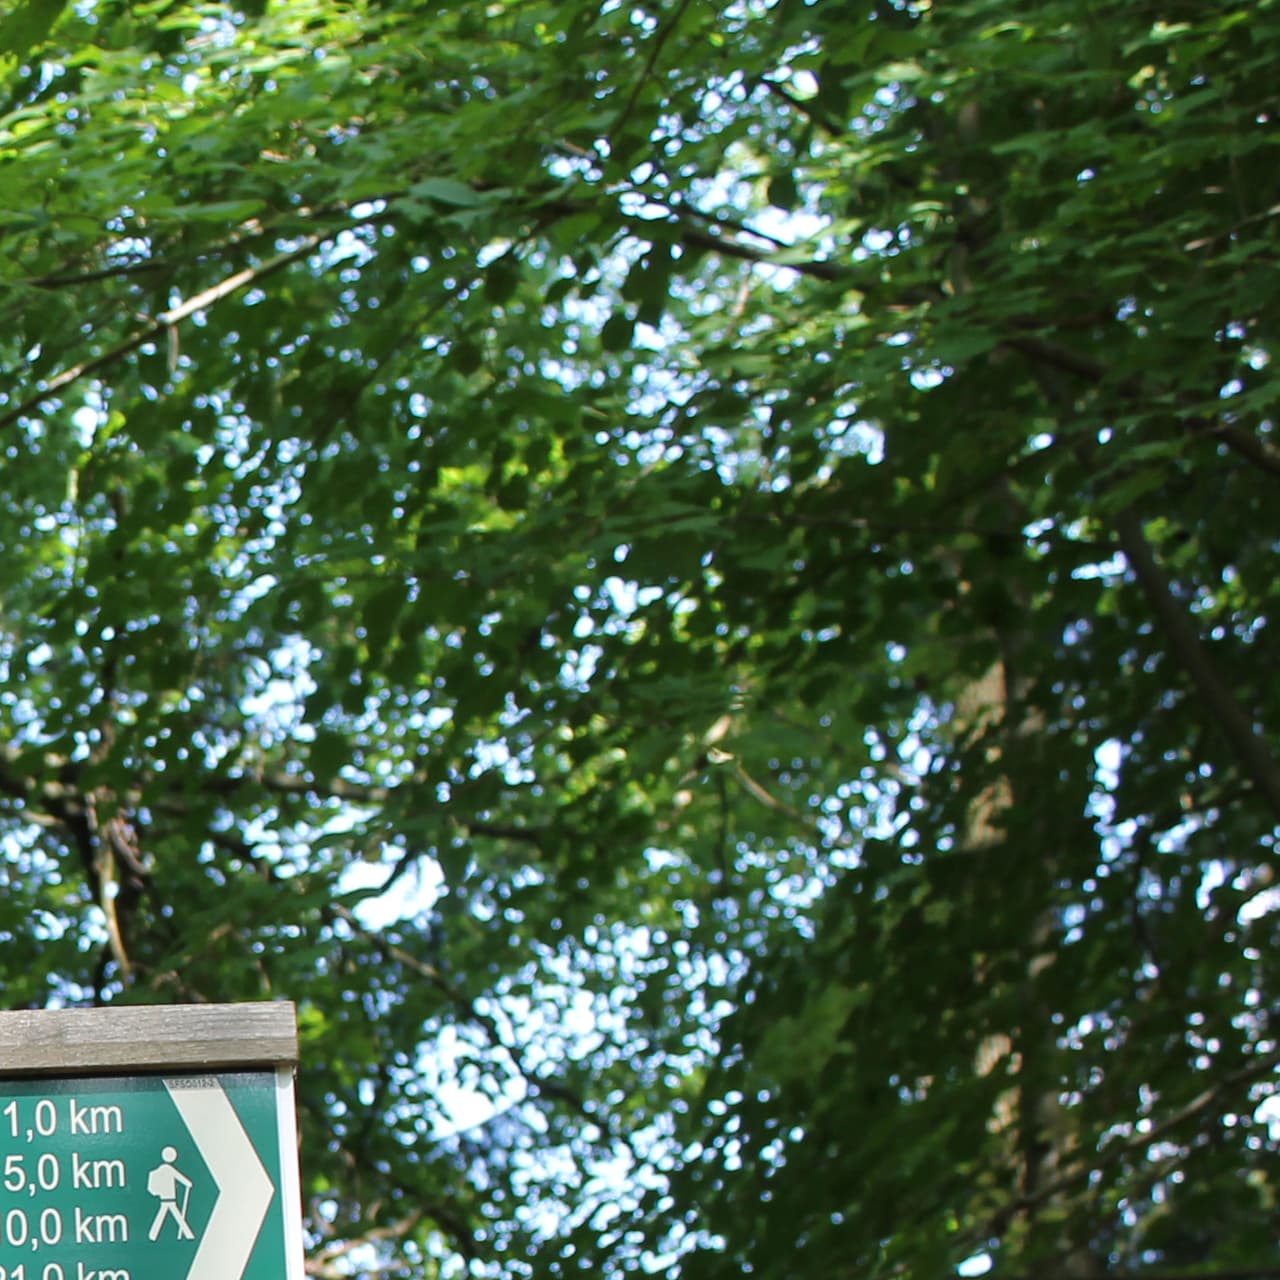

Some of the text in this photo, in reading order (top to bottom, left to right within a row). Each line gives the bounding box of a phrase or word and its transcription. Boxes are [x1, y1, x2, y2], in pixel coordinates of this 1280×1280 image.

[3, 1100, 57, 1143] 1,0
[69, 1098, 123, 1135] km
[4, 1153, 60, 1197] 5,0
[72, 1152, 126, 1189] km
[74, 1207, 128, 1243] km
